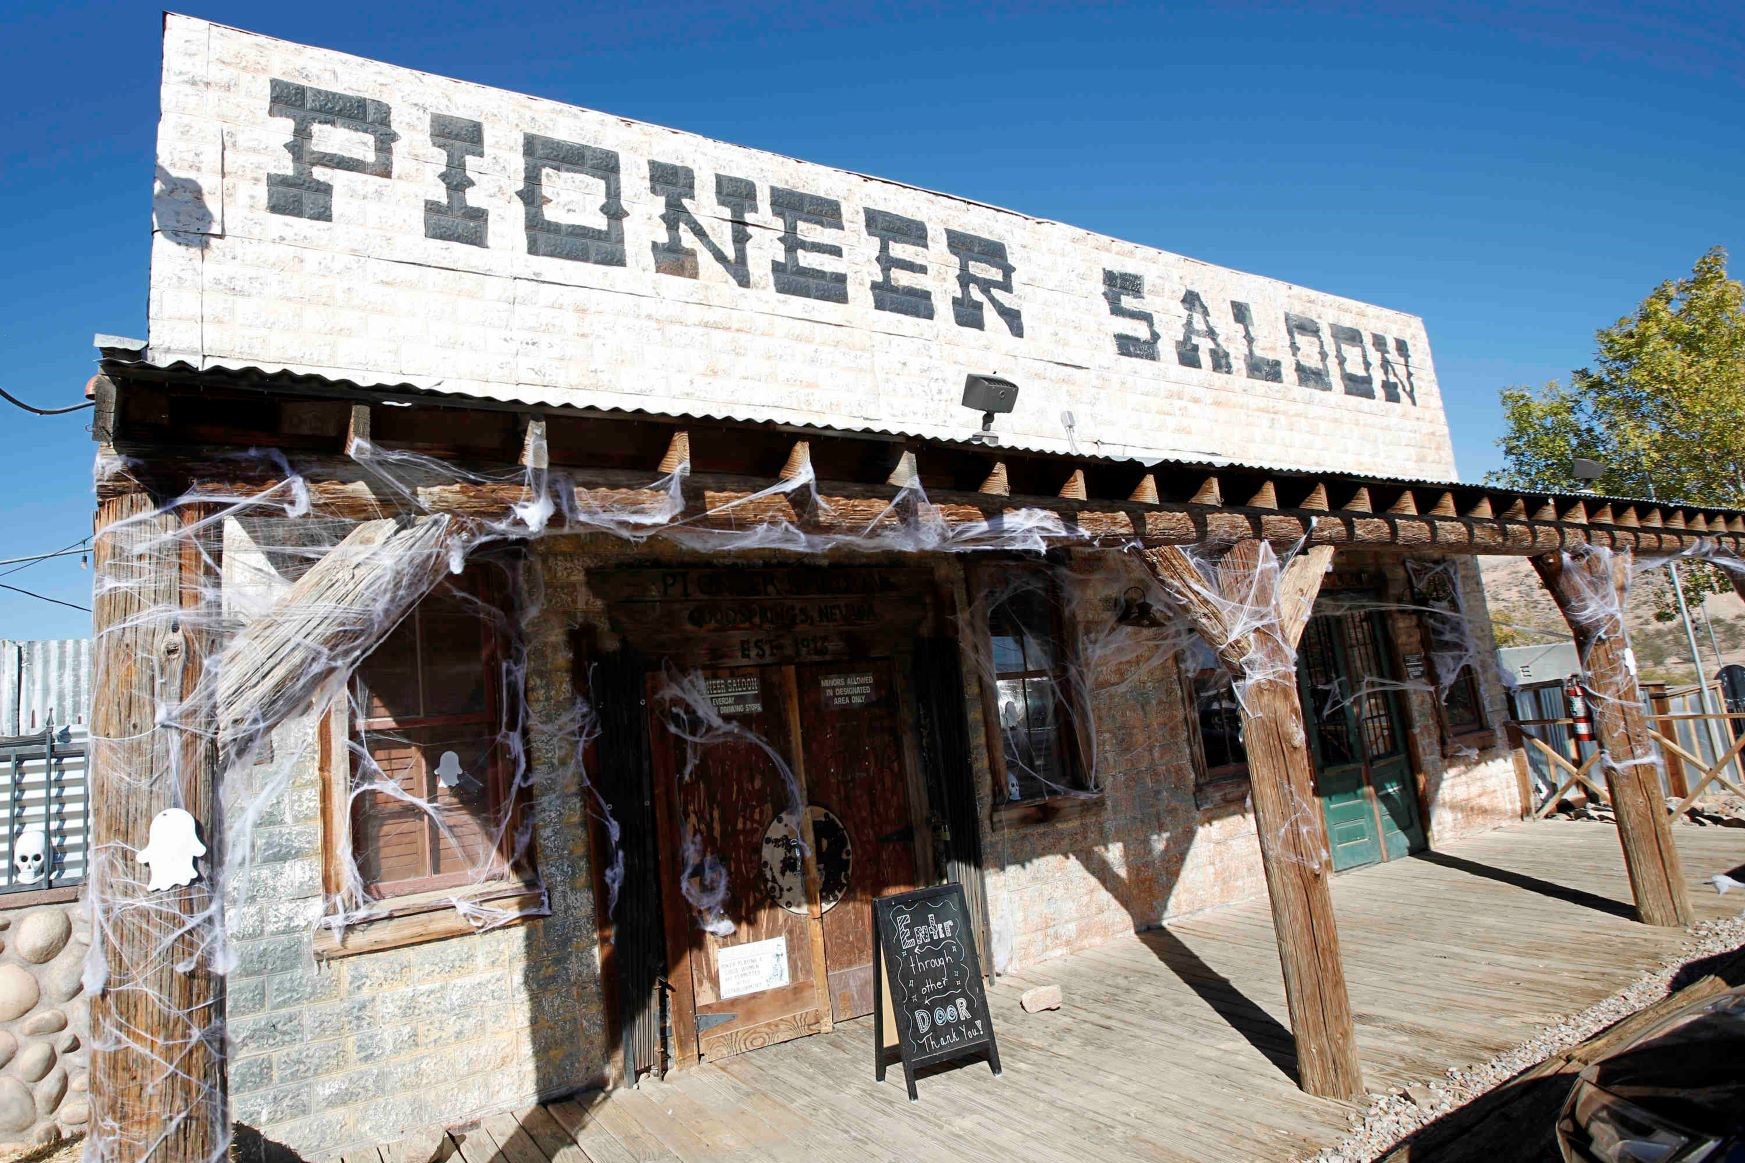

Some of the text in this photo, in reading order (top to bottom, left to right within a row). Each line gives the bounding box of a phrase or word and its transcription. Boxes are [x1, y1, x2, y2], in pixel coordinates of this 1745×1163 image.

[266, 78, 1416, 407] PIONEER SALOON
[727, 677, 758, 692] SALOON
[821, 676, 873, 687] MINORS ALLOWED
[835, 686, 871, 696] DESIGNATED
[833, 695, 866, 705] AREA ONLY
[897, 913, 954, 949] Enter
[909, 950, 954, 979] through
[921, 976, 948, 995] other
[914, 997, 972, 1034] DOOR
[917, 1020, 984, 1053] Thank You!
